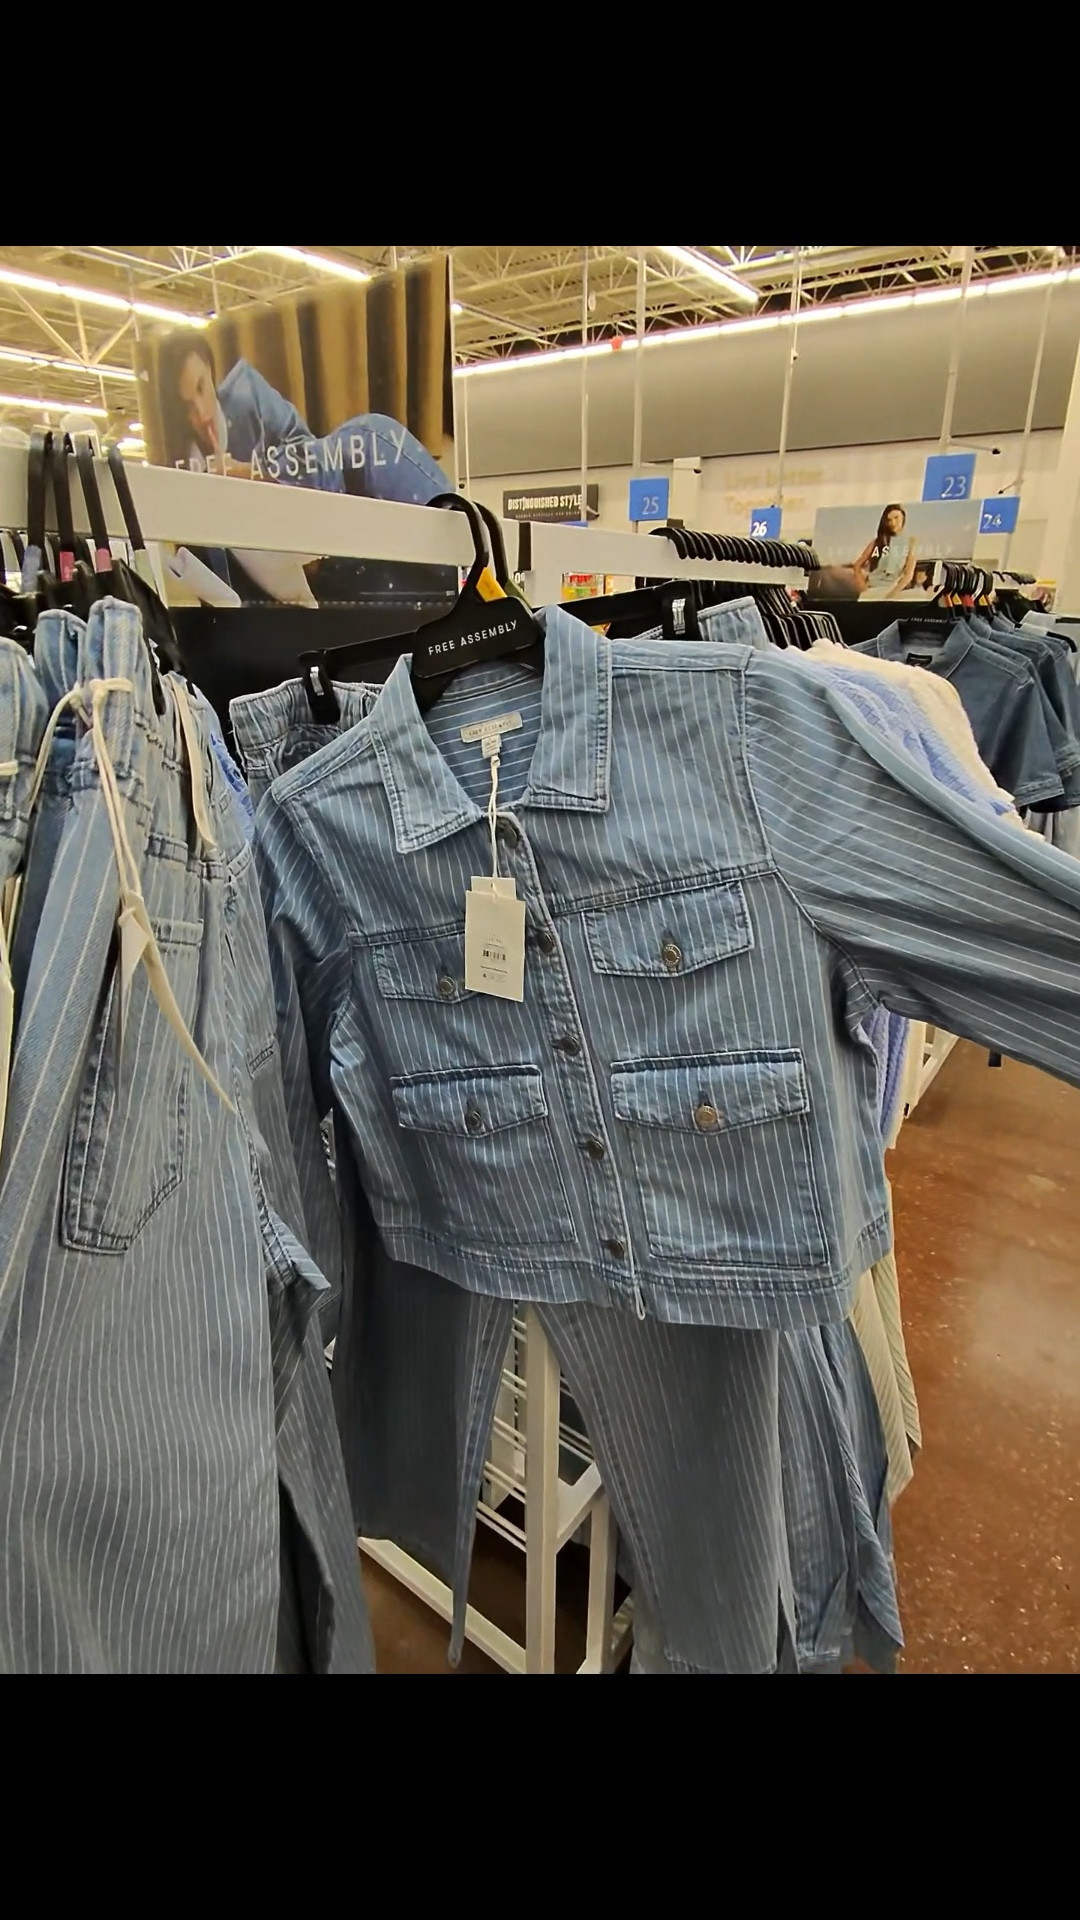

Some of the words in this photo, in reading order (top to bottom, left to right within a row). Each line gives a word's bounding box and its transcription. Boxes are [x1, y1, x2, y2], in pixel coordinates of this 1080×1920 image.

[250, 428, 407, 480] ASSEMBLY
[941, 475, 966, 498] 23
[642, 496, 659, 515] 25
[752, 521, 767, 537] 26
[982, 513, 1002, 529] 24
[428, 640, 456, 656] FREE
[460, 619, 518, 647] ASSEMBLY
